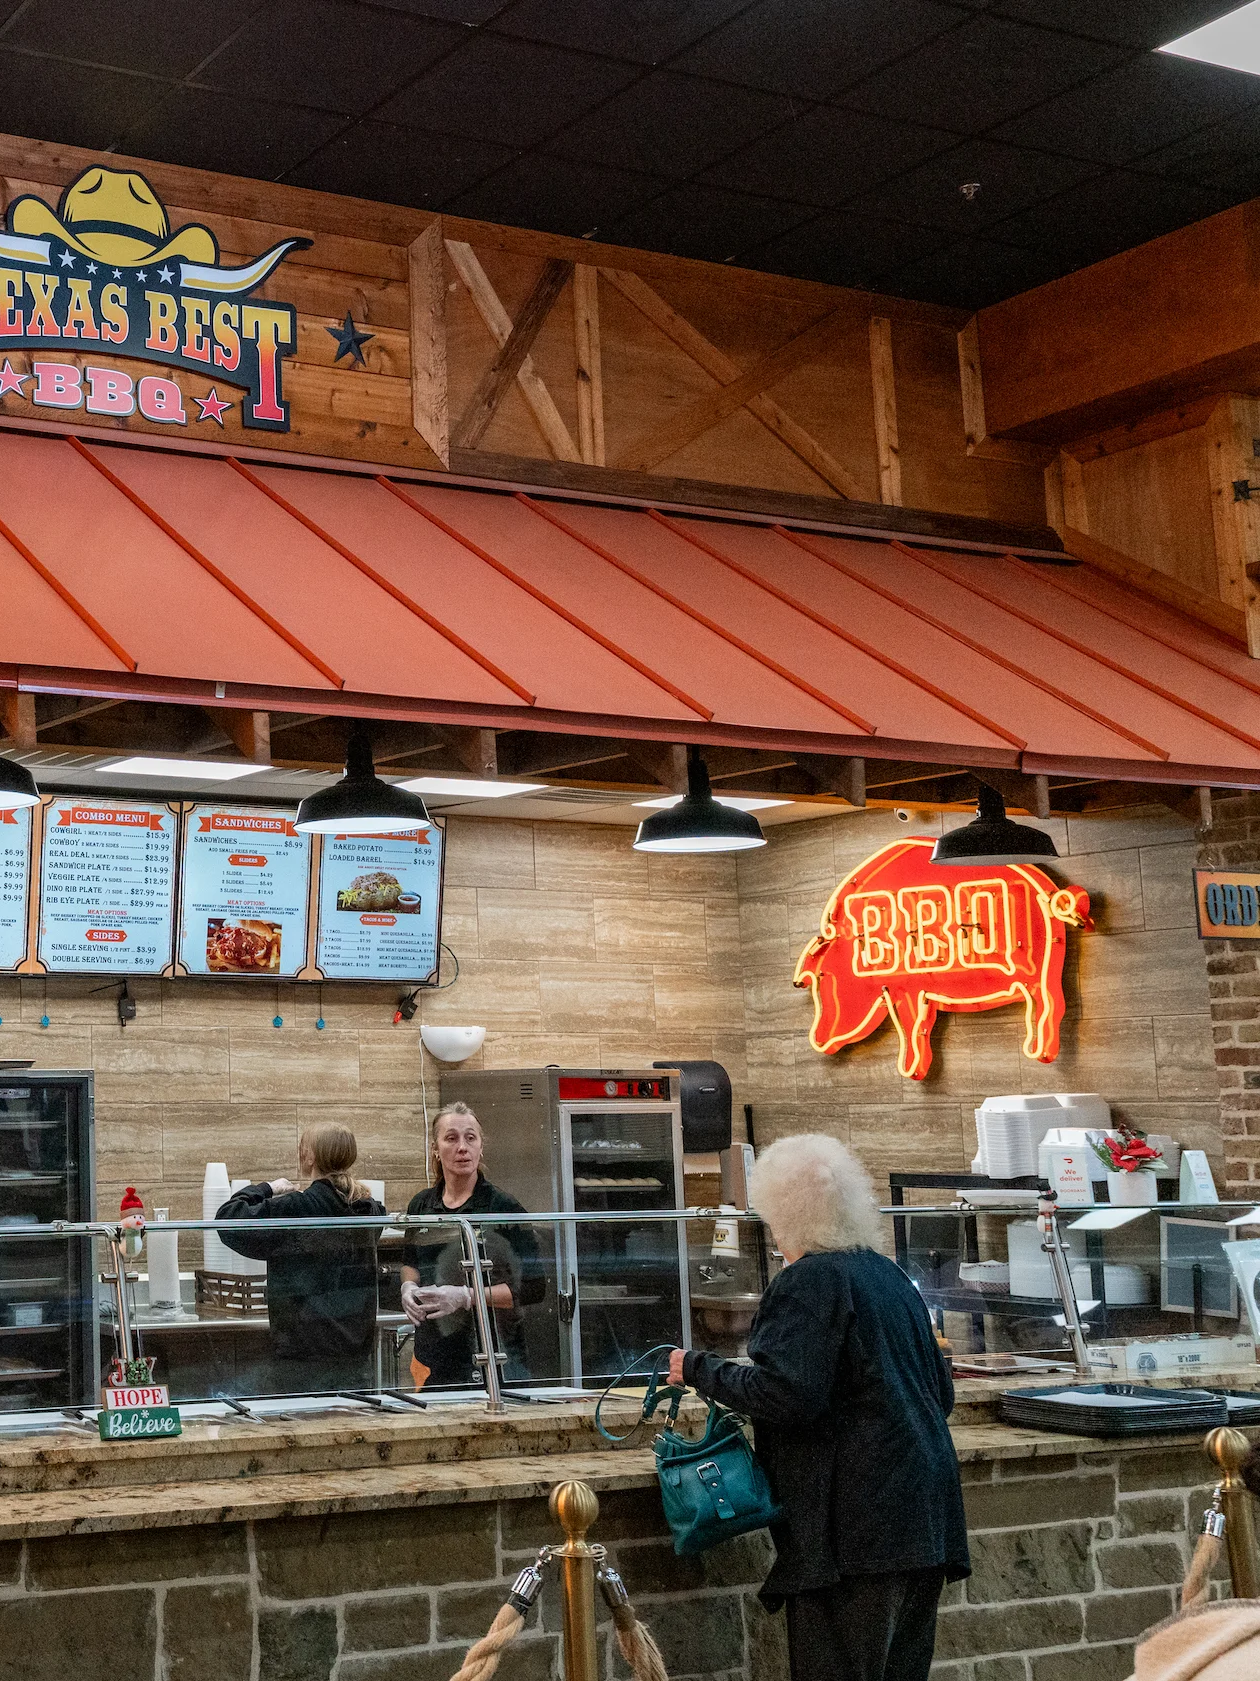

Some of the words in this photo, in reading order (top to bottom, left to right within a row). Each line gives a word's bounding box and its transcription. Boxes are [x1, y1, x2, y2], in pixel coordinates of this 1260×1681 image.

[145, 290, 292, 421] BEST
[33, 362, 187, 424] BBQ
[76, 811, 112, 821] COMBO
[116, 814, 145, 823] MENU
[215, 818, 281, 829] SANDWICHES
[194, 836, 237, 844] SANDWICHES
[48, 873, 75, 881] VEGGIE
[1205, 883, 1260, 926] ORD
[844, 878, 1016, 977] BBQ
[112, 1389, 162, 1406] HOPE
[110, 1413, 175, 1437] Believe
